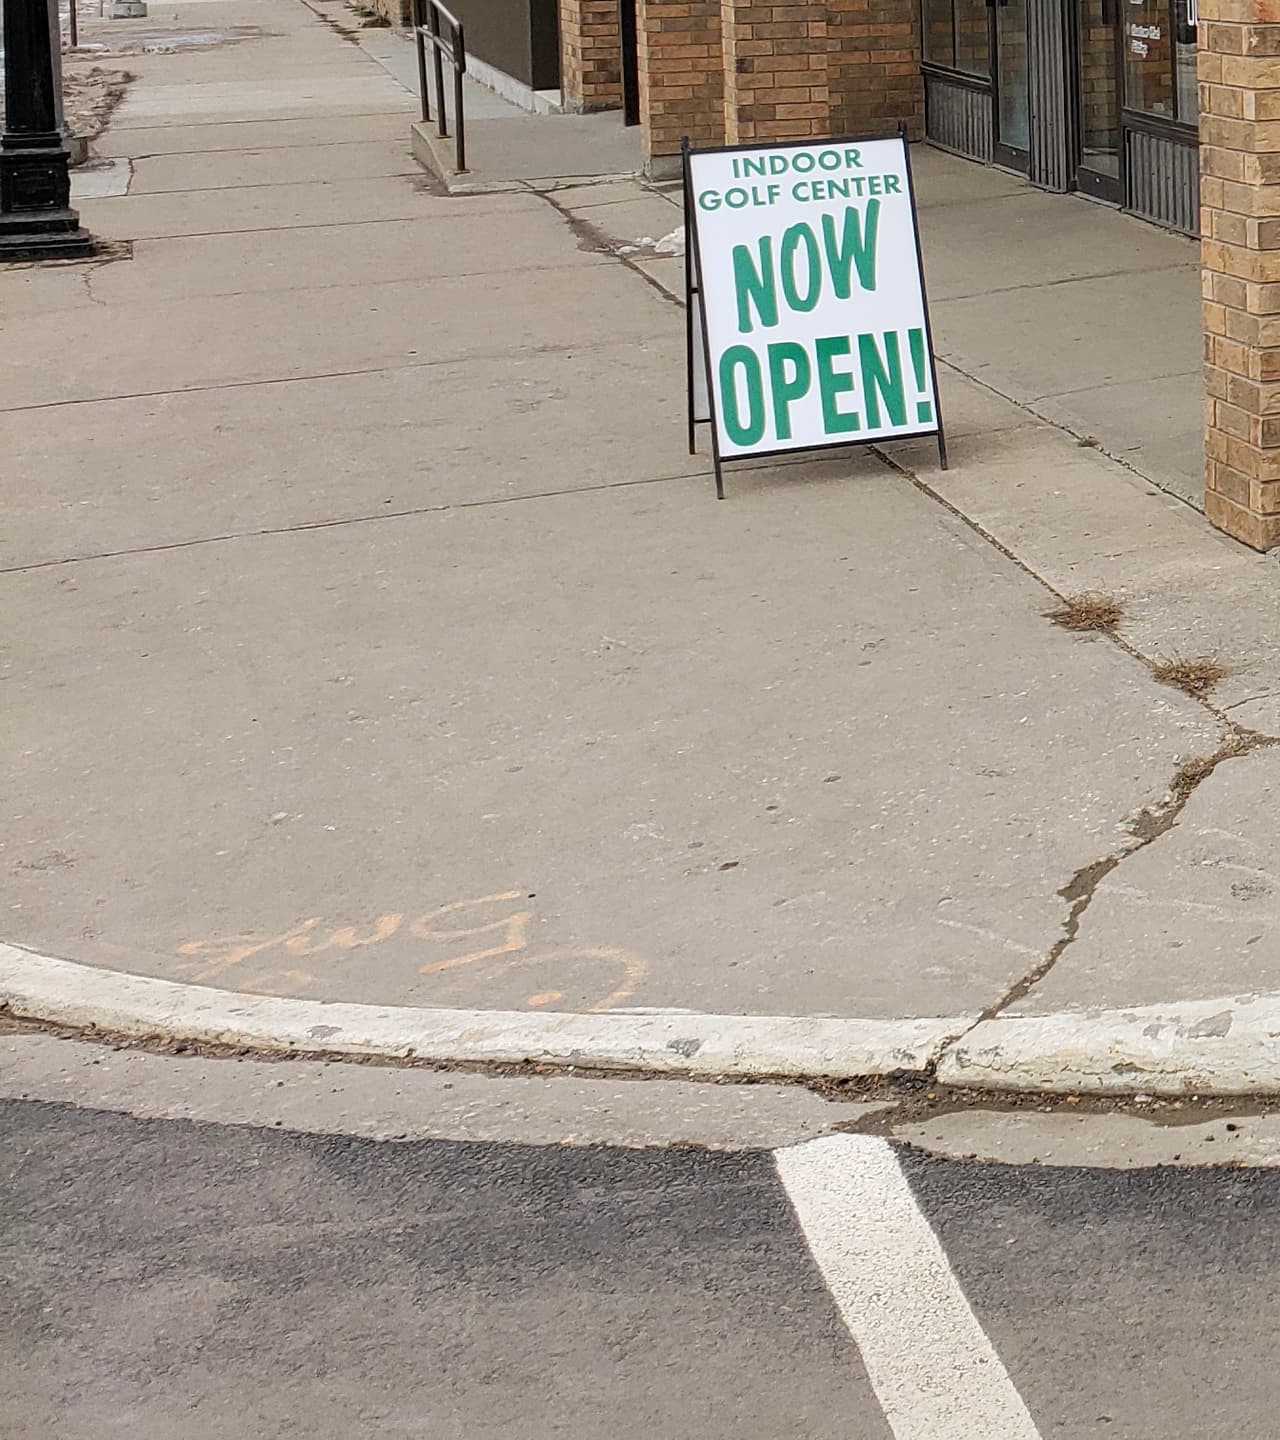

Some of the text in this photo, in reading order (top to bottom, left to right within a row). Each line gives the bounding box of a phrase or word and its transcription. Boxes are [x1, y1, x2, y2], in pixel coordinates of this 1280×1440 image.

[699, 174, 903, 211] GOLF CENTER
[732, 148, 864, 179] INDOOR
[733, 198, 881, 333] NOW
[719, 328, 933, 447] OPEN!
